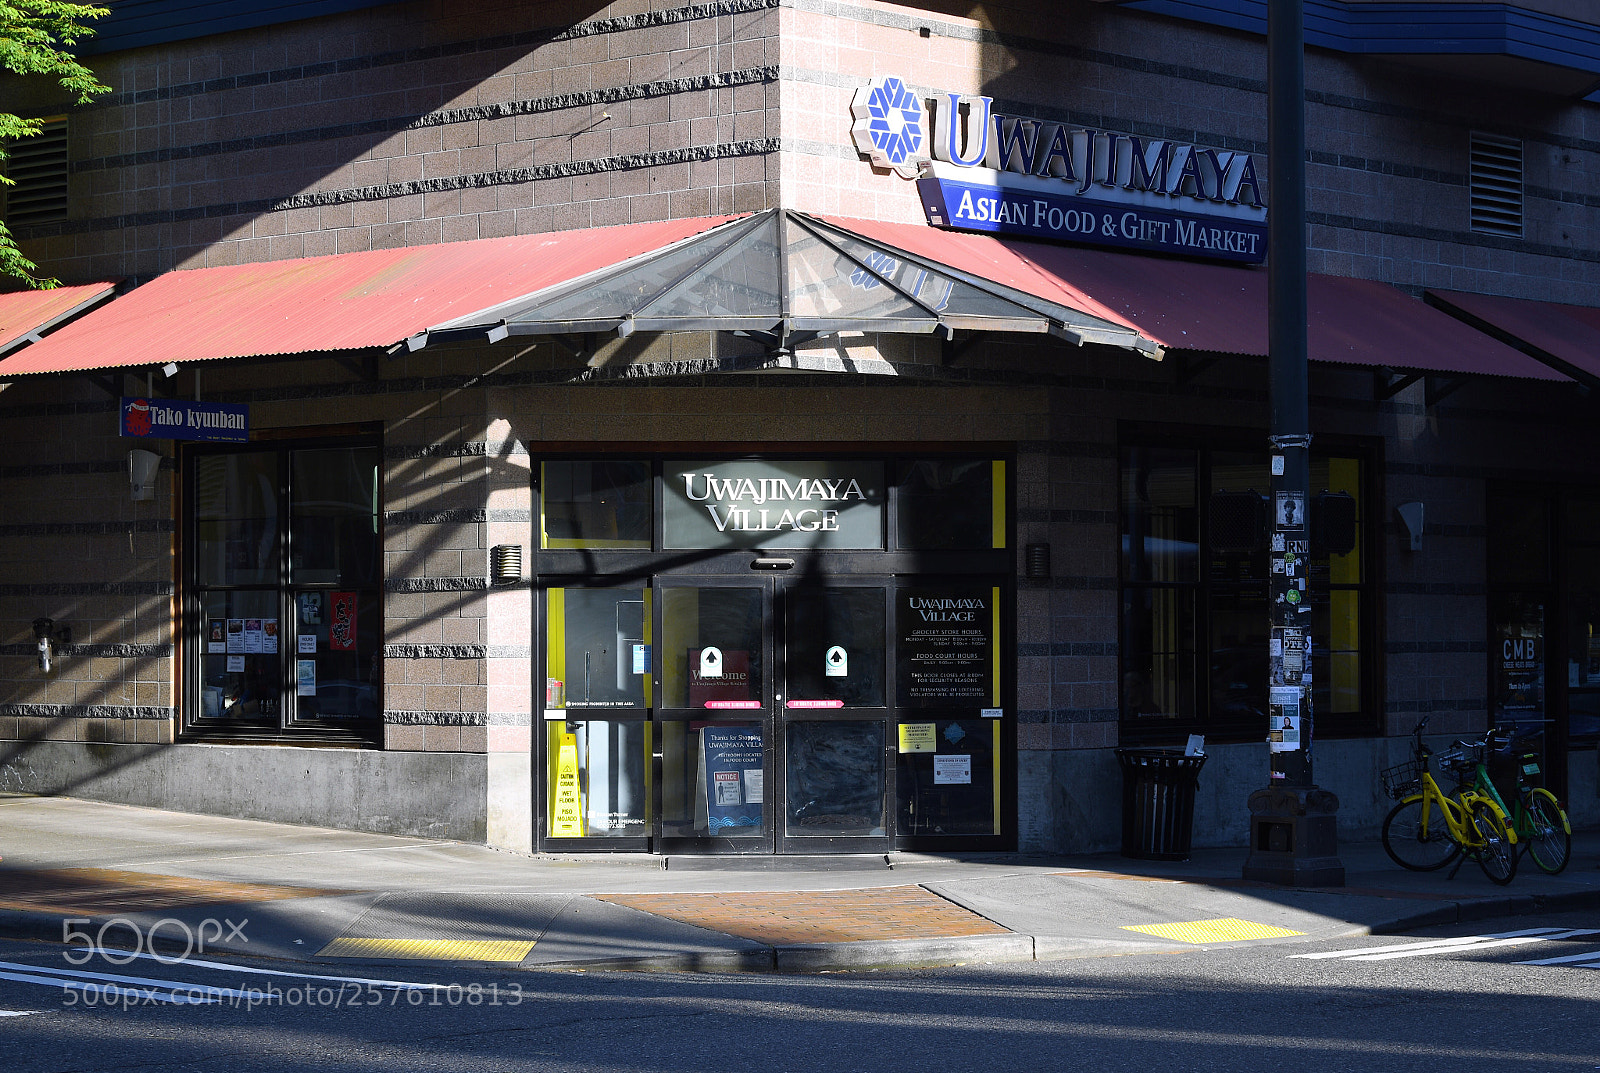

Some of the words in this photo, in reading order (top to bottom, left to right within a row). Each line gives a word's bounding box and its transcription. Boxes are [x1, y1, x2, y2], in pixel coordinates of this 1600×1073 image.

[934, 93, 1267, 207] UWAJIMAYA
[955, 189, 1028, 226] ASIAN
[1032, 200, 1096, 235] FOOD
[1103, 216, 1117, 237] &
[1120, 212, 1171, 245] GIFT
[1173, 218, 1260, 255] MARKET
[150, 406, 182, 426] Tako
[187, 408, 245, 430] kyuuban
[682, 473, 867, 505] UWAJIMAYA
[705, 504, 840, 532] VILLAGE
[909, 597, 985, 610] UWAJIMAYA
[919, 610, 976, 622] VILLAGE
[1503, 639, 1535, 660] CMB
[738, 734, 762, 742] Shopping
